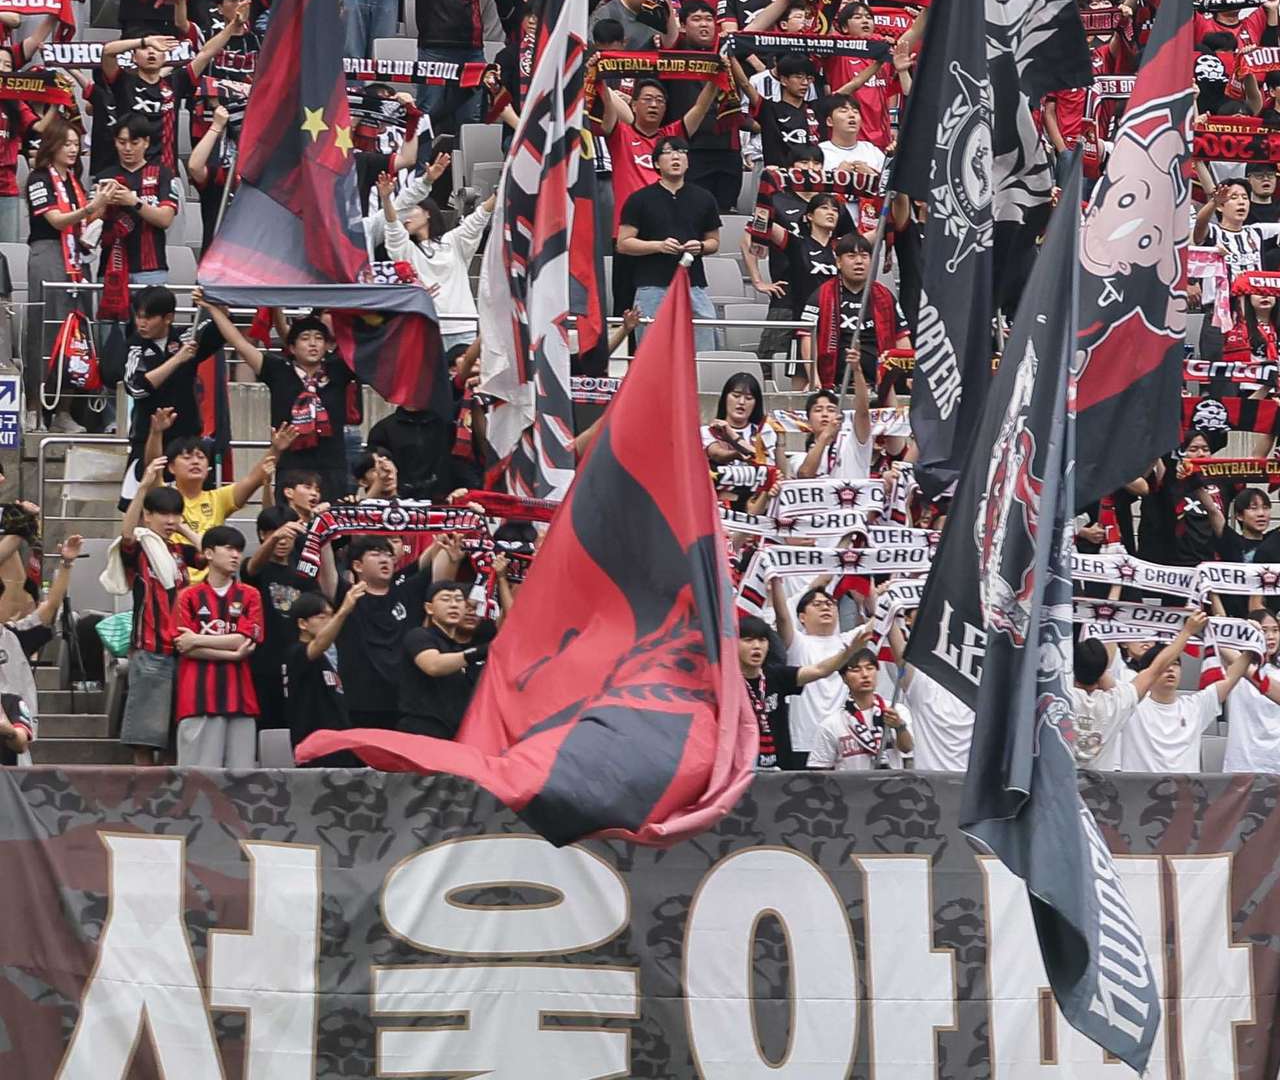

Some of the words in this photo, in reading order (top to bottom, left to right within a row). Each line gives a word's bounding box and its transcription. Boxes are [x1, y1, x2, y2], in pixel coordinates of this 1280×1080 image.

[378, 61, 414, 76] CLUB
[418, 63, 459, 80] SEOUL
[599, 57, 653, 75] FOOTBALL
[656, 59, 685, 73] CLUB
[688, 58, 720, 74] SEOUL
[0, 431, 16, 444] XIT
[1200, 464, 1263, 477] FOOTBALL
